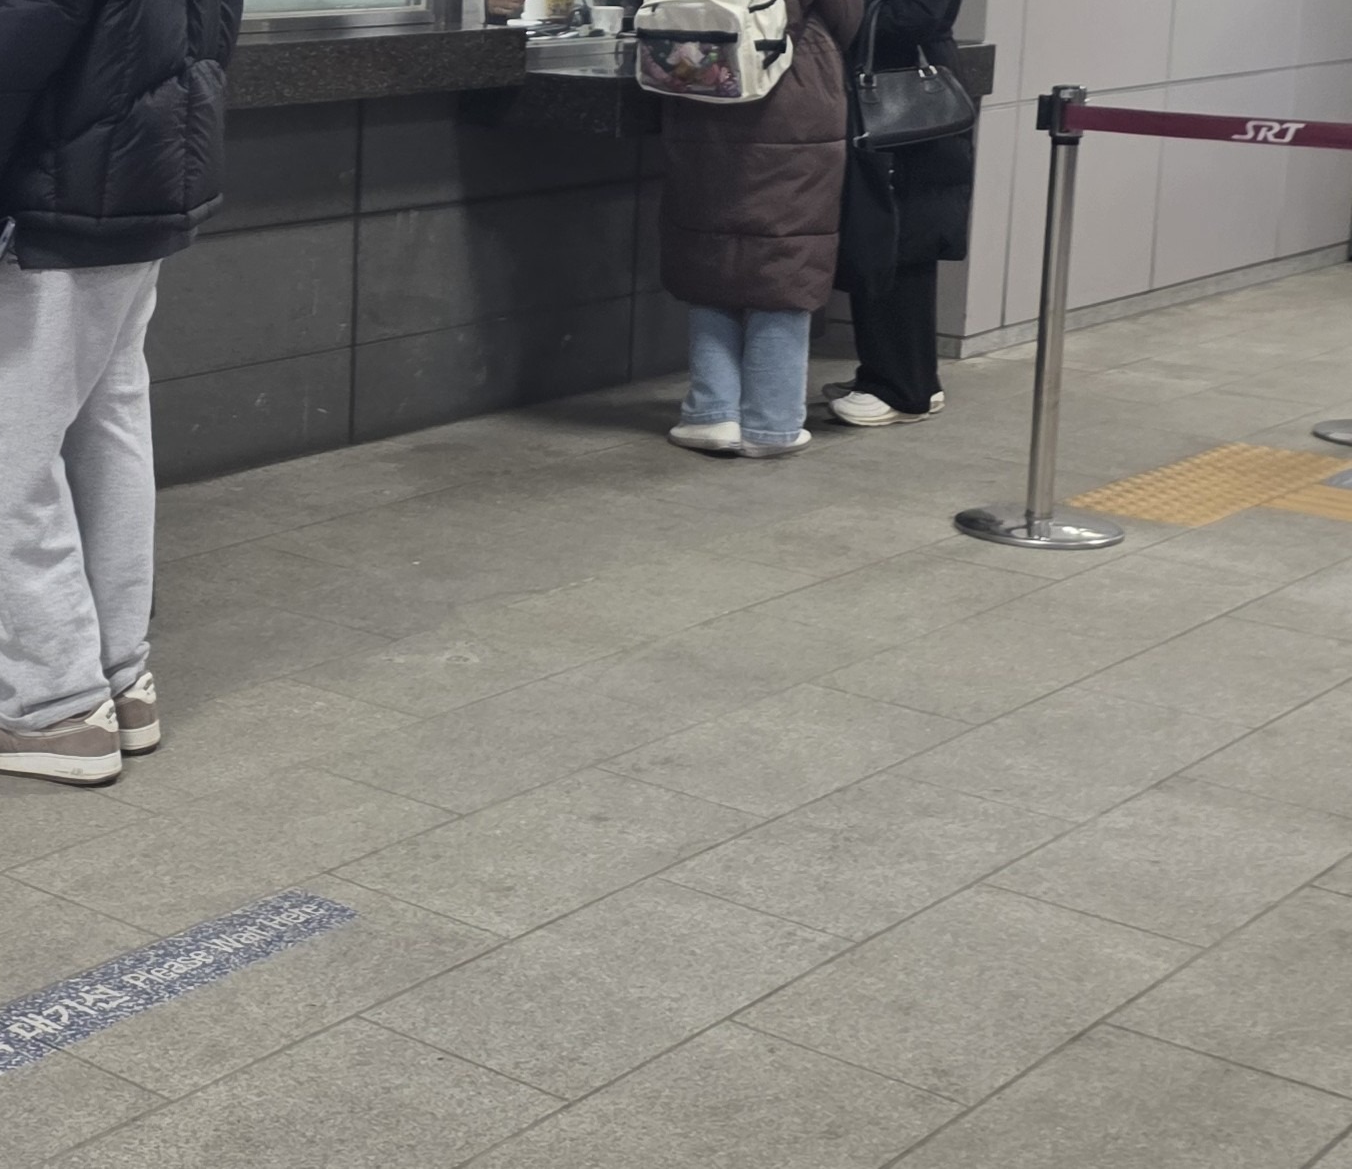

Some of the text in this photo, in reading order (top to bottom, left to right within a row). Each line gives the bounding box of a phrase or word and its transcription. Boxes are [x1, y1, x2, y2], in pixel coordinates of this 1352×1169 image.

[1231, 120, 1306, 143] SRT
[8, 984, 130, 1035] 대기선
[123, 950, 214, 992] Please
[205, 920, 264, 956] Wait
[255, 901, 328, 936] Here
